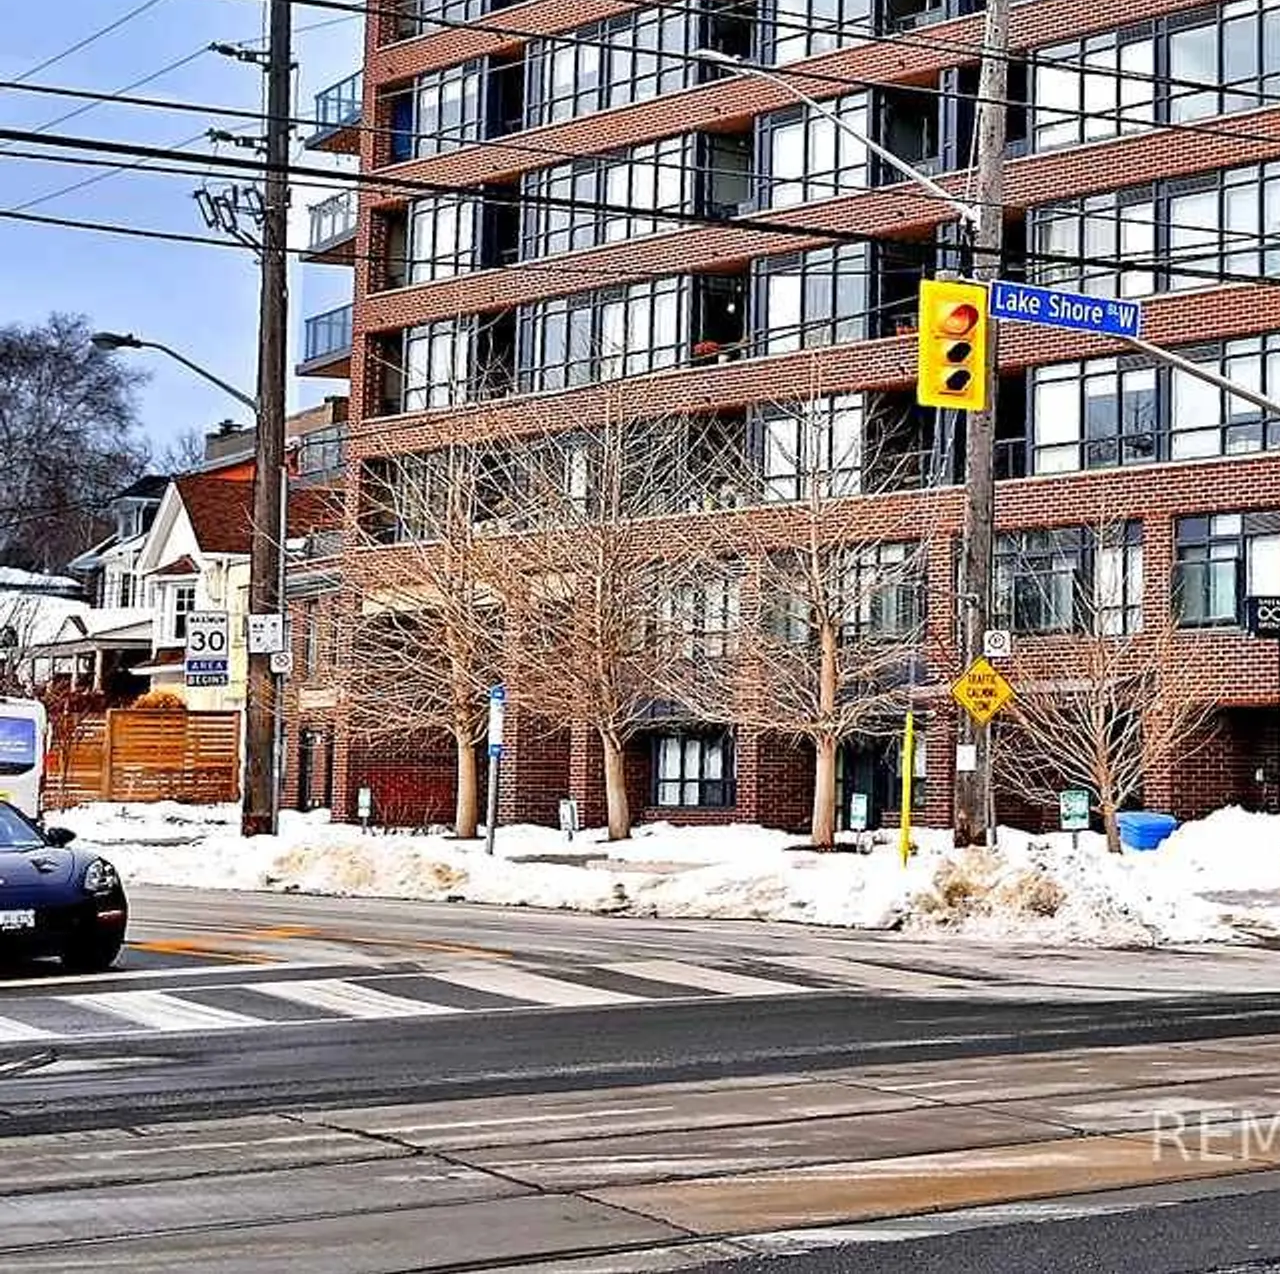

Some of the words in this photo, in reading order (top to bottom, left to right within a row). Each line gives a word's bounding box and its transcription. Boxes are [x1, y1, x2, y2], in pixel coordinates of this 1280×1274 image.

[995, 286, 1041, 315] Lake
[1049, 294, 1103, 324] Shore
[1119, 305, 1135, 328] W
[190, 616, 226, 624] MAXIMUM
[190, 630, 225, 652] 30
[191, 661, 224, 671] AREA
[187, 675, 226, 686] BEGINS
